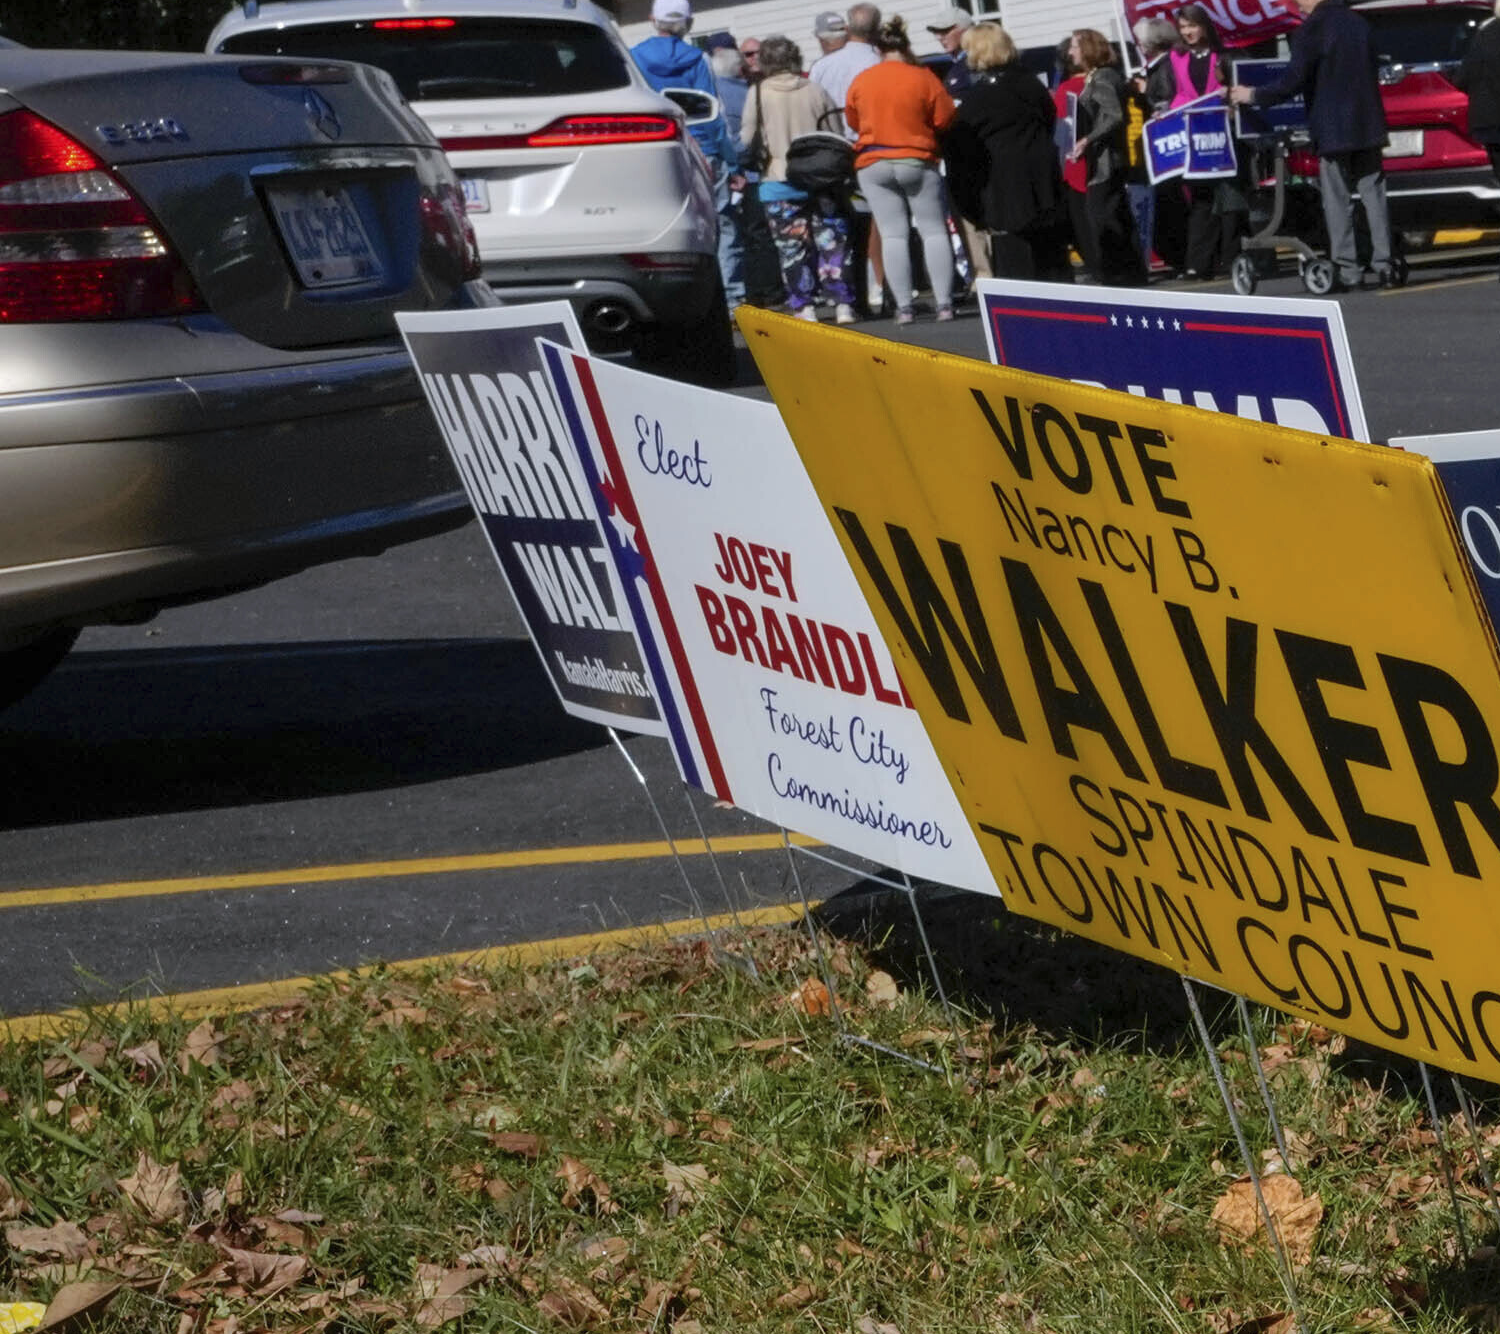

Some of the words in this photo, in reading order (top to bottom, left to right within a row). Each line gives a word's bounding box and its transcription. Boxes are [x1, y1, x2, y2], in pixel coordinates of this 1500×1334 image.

[424, 371, 596, 520] HARRI
[634, 414, 712, 488] Elect
[970, 388, 1192, 519] VOTE
[714, 532, 798, 602] JOEY
[991, 481, 1161, 594] Nancy
[1172, 528, 1241, 600] B.
[554, 650, 652, 698] KamalaHarris.
[694, 584, 916, 710] BRANDL
[760, 687, 843, 753] Forest
[849, 716, 909, 784] City
[767, 753, 952, 849] Commissioner
[980, 824, 1222, 975] TOWN
[1069, 776, 1433, 961] SPINDALE
